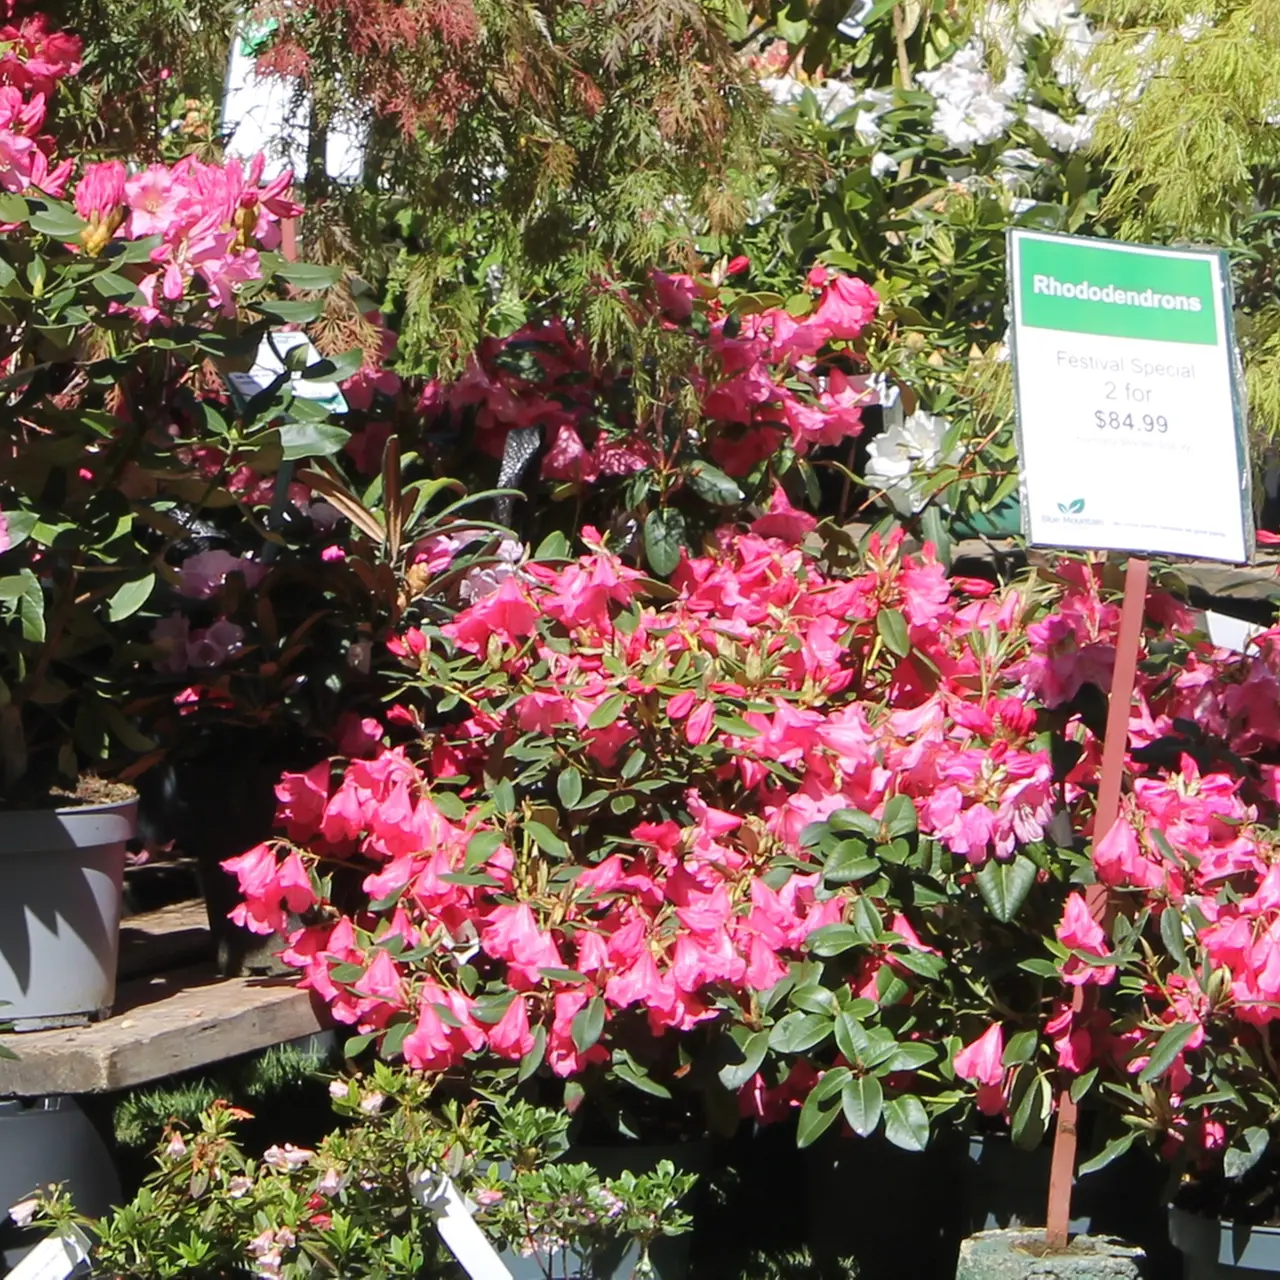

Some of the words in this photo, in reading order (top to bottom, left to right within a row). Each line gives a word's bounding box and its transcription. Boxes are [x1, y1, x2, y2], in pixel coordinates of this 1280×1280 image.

[1033, 274, 1202, 312] Rhododendrons
[1056, 350, 1124, 372] Festival
[1131, 357, 1196, 379] Special
[1104, 381, 1117, 401] 2
[1125, 382, 1153, 403] for
[1094, 409, 1169, 434] $84.99
